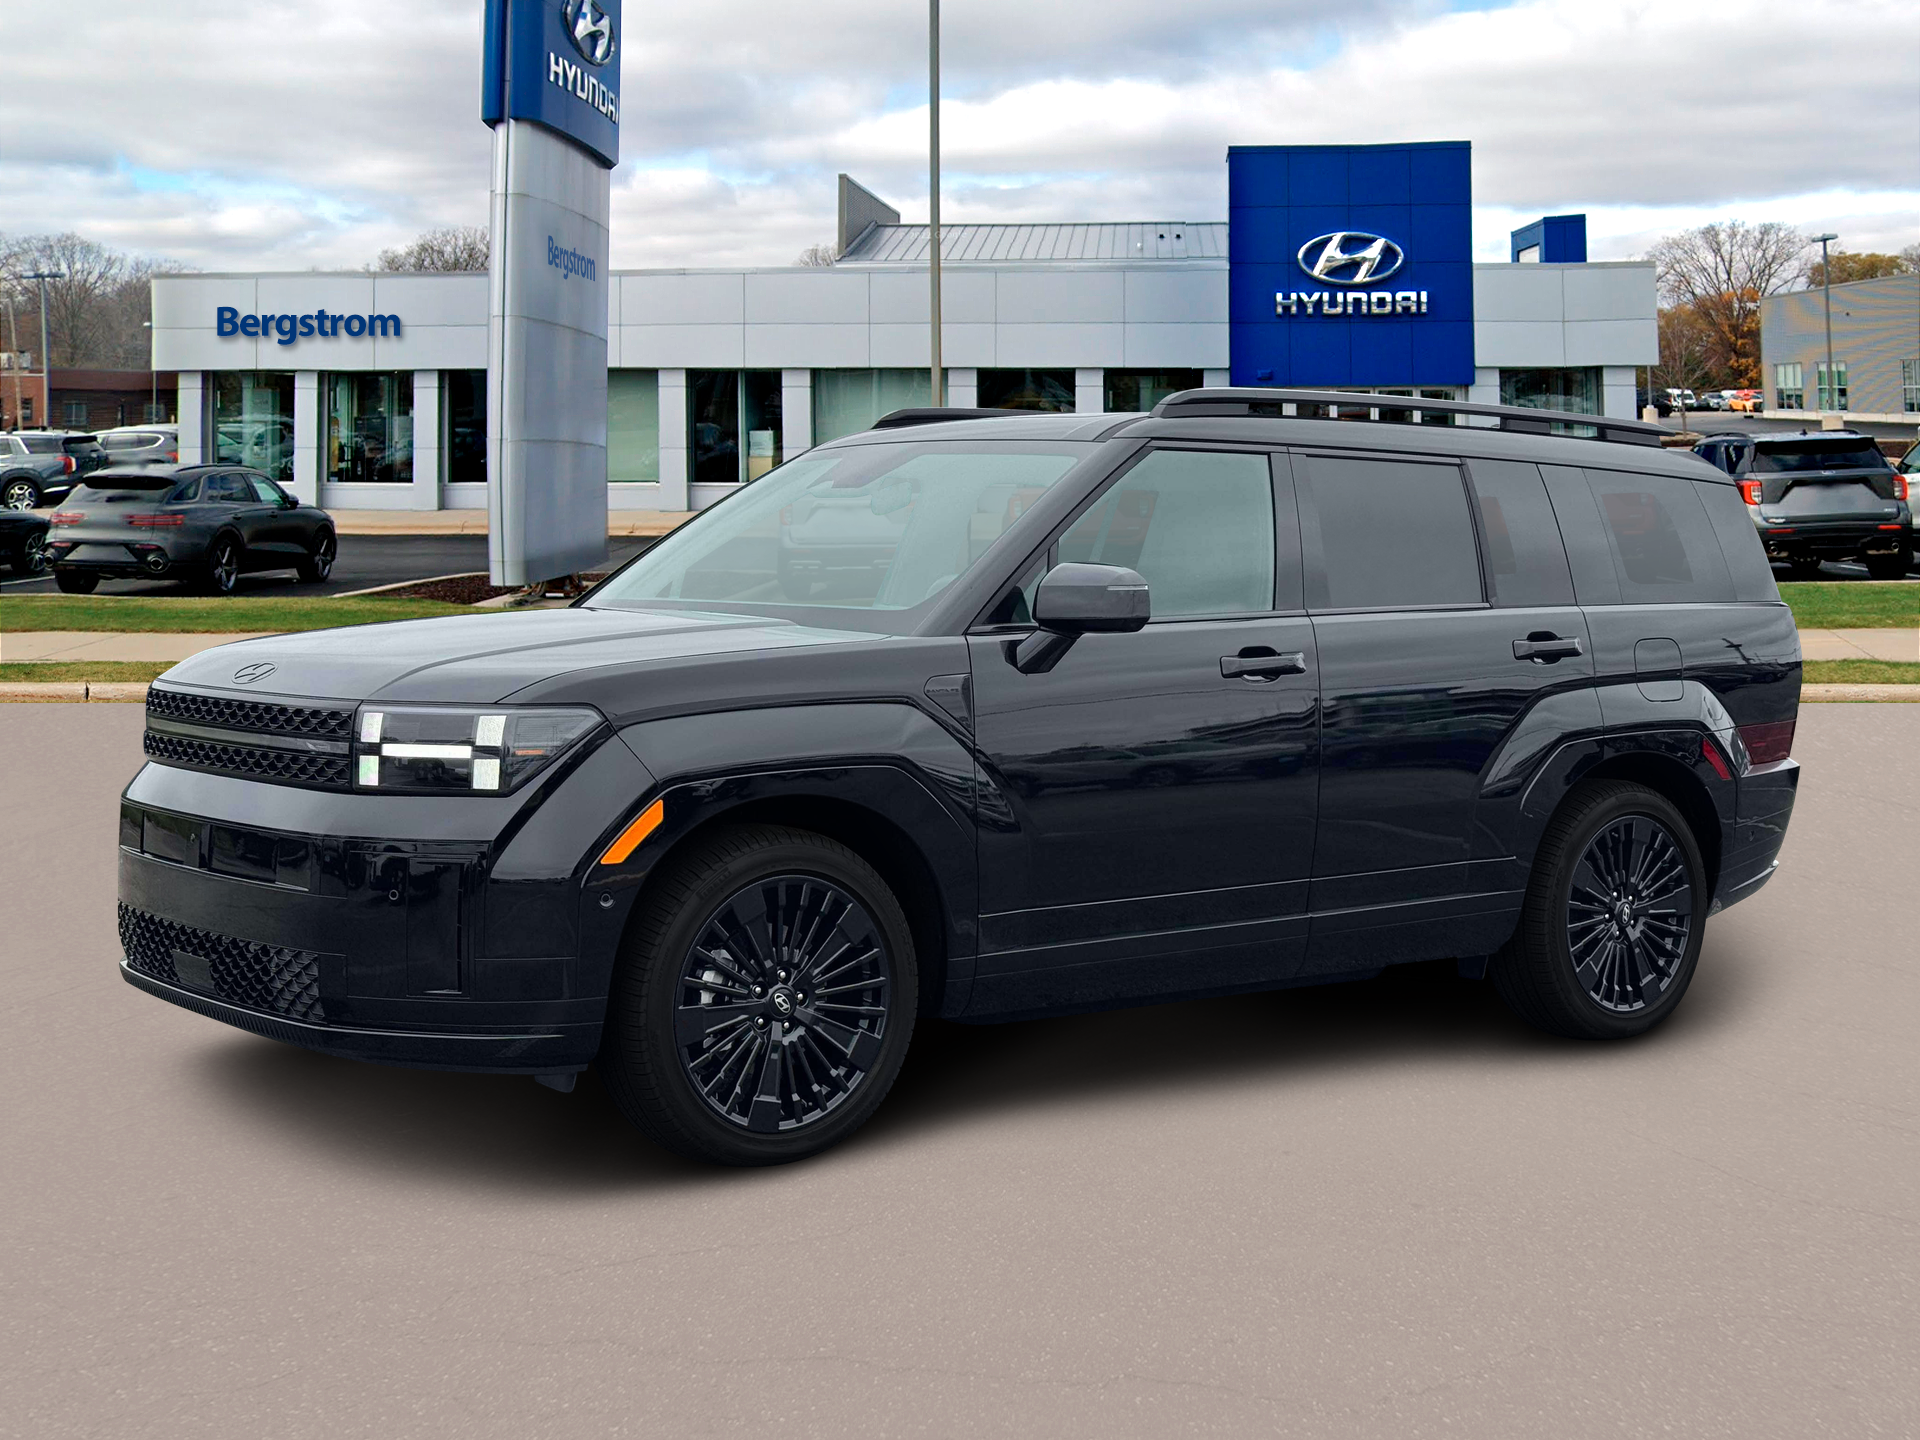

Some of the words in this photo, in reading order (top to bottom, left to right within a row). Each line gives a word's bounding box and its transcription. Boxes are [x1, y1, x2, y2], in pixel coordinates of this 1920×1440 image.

[549, 52, 619, 124] HYUNDAI
[547, 234, 595, 282] Bergstrom
[1275, 290, 1428, 315] HYUNDAI
[216, 306, 401, 346] Bergstrom
